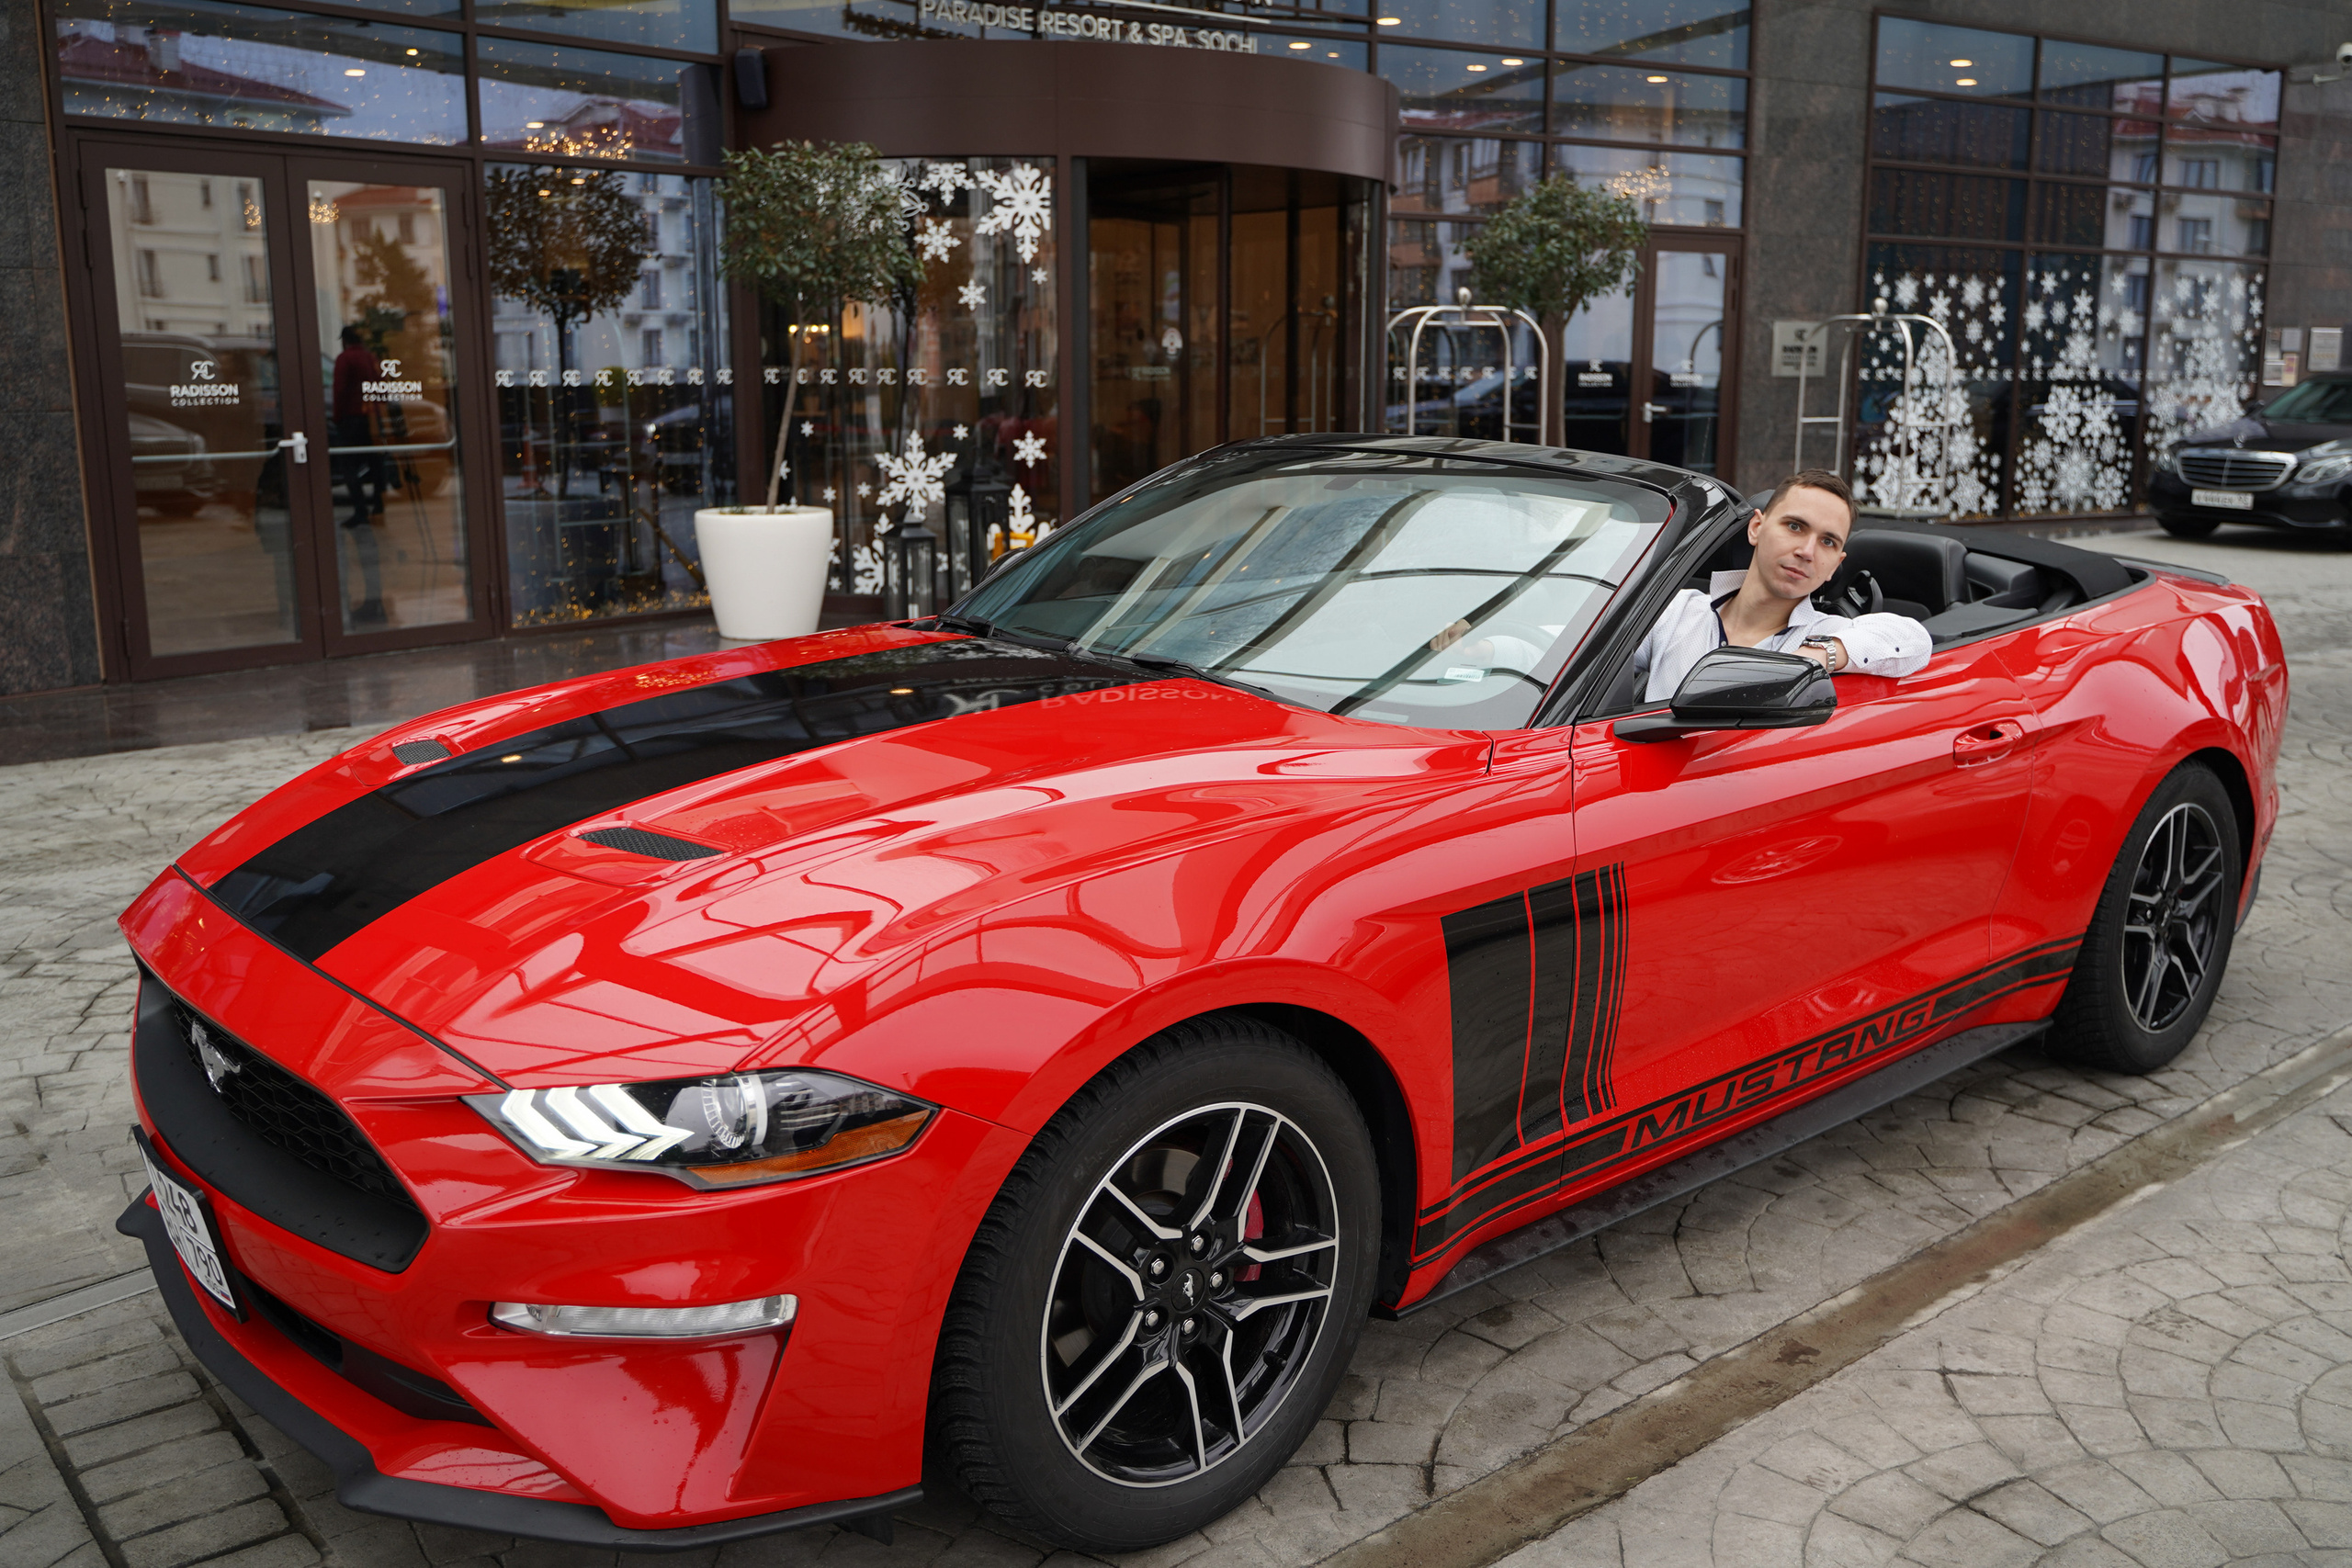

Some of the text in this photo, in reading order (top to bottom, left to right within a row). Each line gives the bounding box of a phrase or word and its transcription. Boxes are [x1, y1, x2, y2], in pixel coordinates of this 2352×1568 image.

[920, 0, 1035, 31] PARADISE
[1037, 10, 1124, 42] RESORT
[1127, 21, 1143, 44] &
[1195, 29, 1258, 54] SOCHI
[170, 383, 239, 398] RADISSON
[362, 381, 423, 394] RADISSON
[171, 397, 240, 407] COLLECTION
[362, 392, 423, 401] COLLECTION
[1631, 999, 1931, 1150] MUSTANG
[185, 1235, 223, 1287] 790
